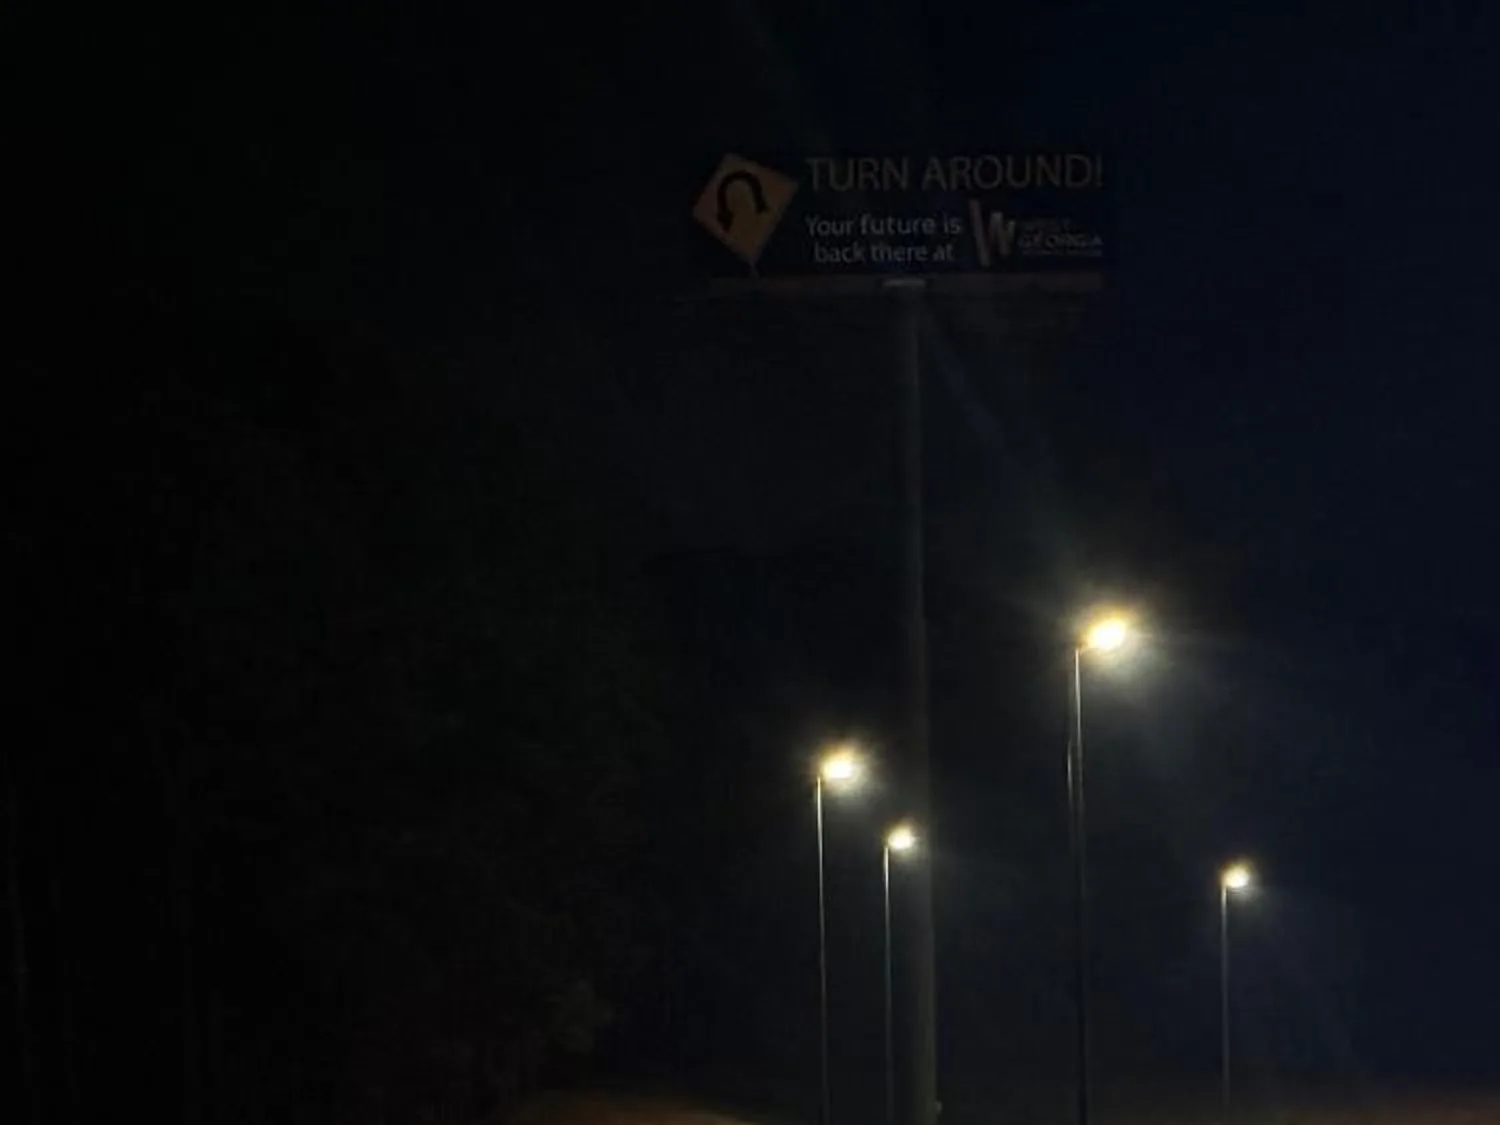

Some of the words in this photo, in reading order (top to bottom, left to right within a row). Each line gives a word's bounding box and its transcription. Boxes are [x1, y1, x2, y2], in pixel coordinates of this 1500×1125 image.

[805, 156, 909, 191] TURN
[922, 154, 1103, 190] AROUND!
[805, 214, 854, 236] Your
[858, 212, 936, 235] future
[943, 213, 962, 235] is
[814, 242, 864, 262] back
[870, 243, 928, 262] there
[932, 242, 955, 261] at
